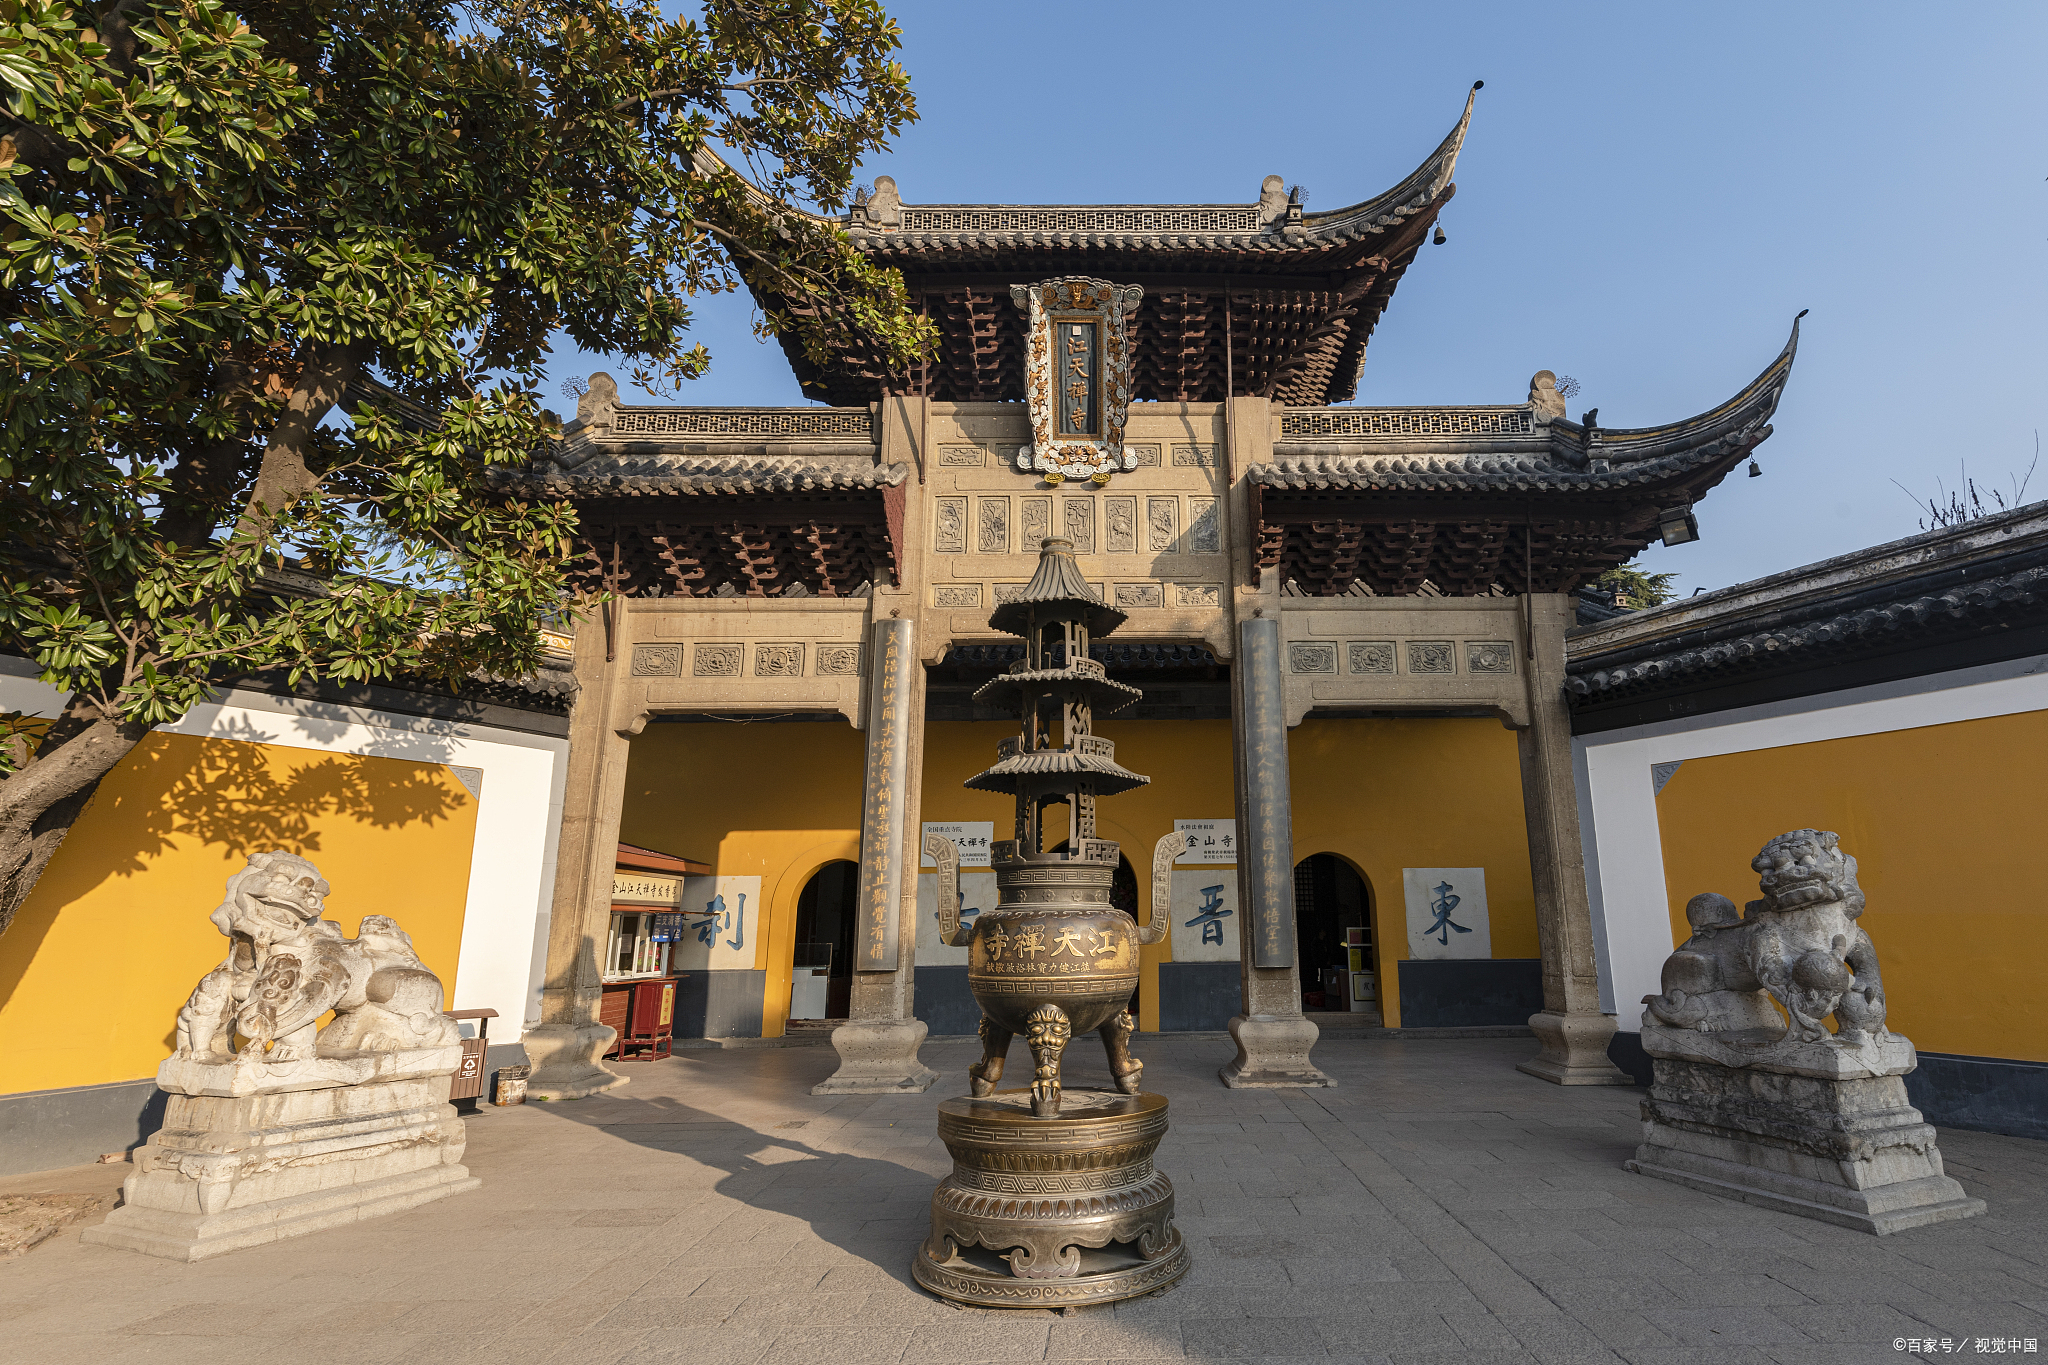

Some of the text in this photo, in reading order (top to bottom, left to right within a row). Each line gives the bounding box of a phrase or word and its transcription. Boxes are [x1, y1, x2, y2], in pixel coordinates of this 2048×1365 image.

[1067, 337, 1089, 430] 江天禪寺
[951, 837, 988, 847] 天禪寺
[1186, 834, 1233, 848] 金山寺
[1424, 880, 1473, 946] 東
[983, 923, 1117, 961] 江天禪寺
